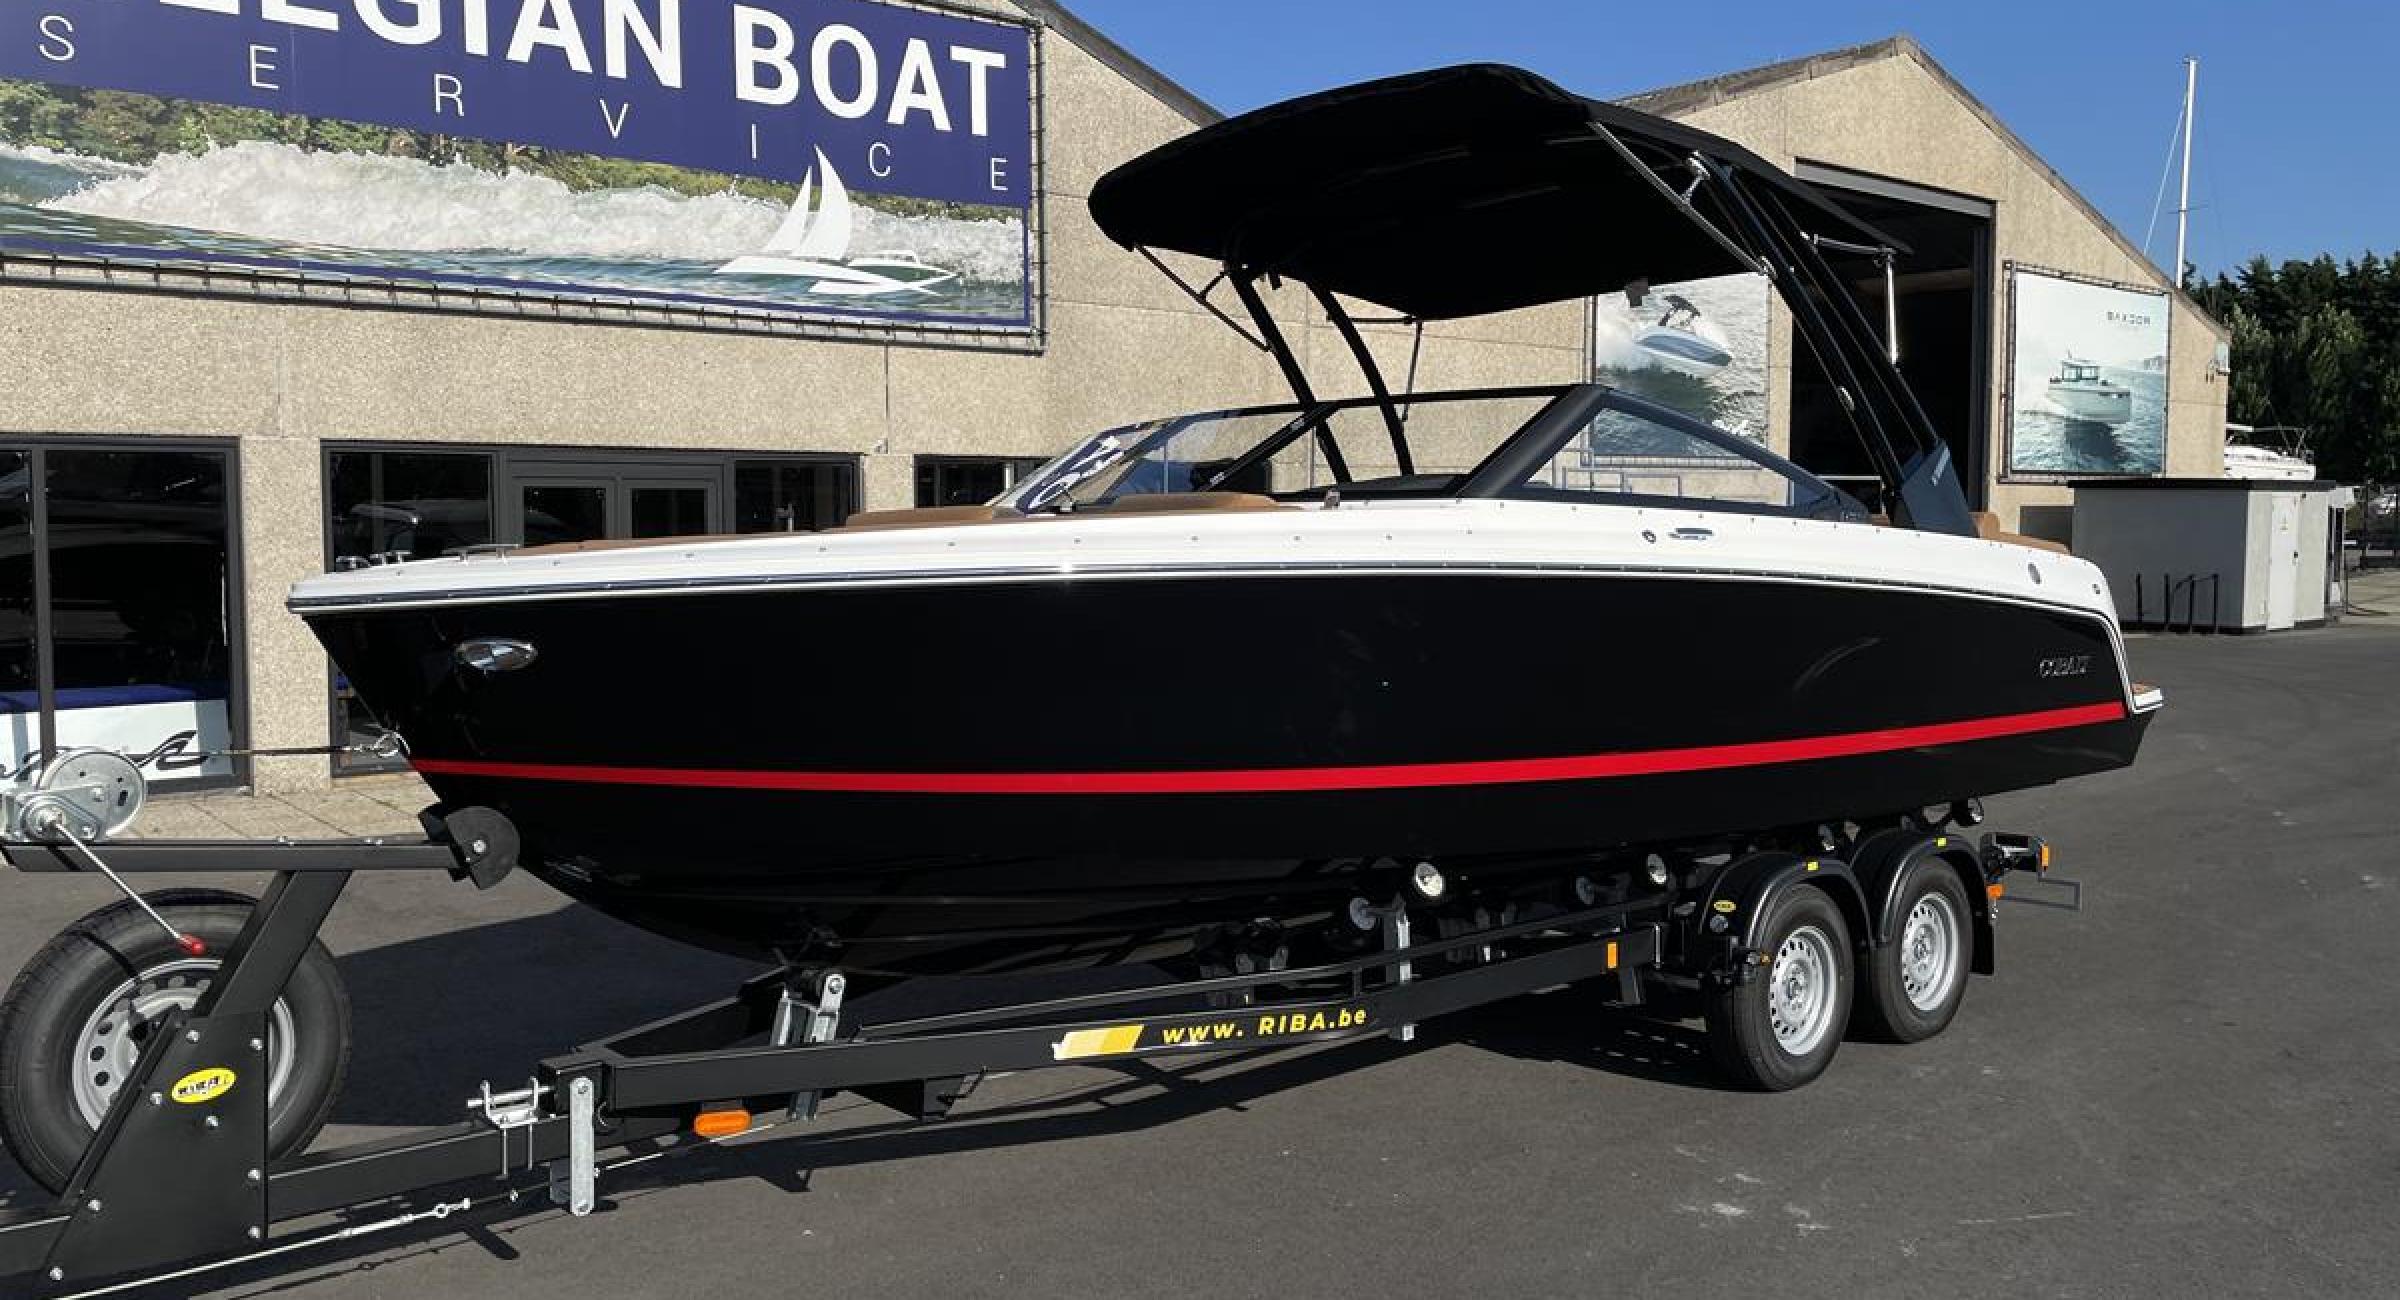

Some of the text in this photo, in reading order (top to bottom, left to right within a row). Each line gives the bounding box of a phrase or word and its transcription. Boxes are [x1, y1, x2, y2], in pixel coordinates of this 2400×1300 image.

[38, 15, 1010, 191] SERVICE
[733, 3, 1007, 137] BOAT
[1162, 1009, 1367, 1044] www. RIBA.be
